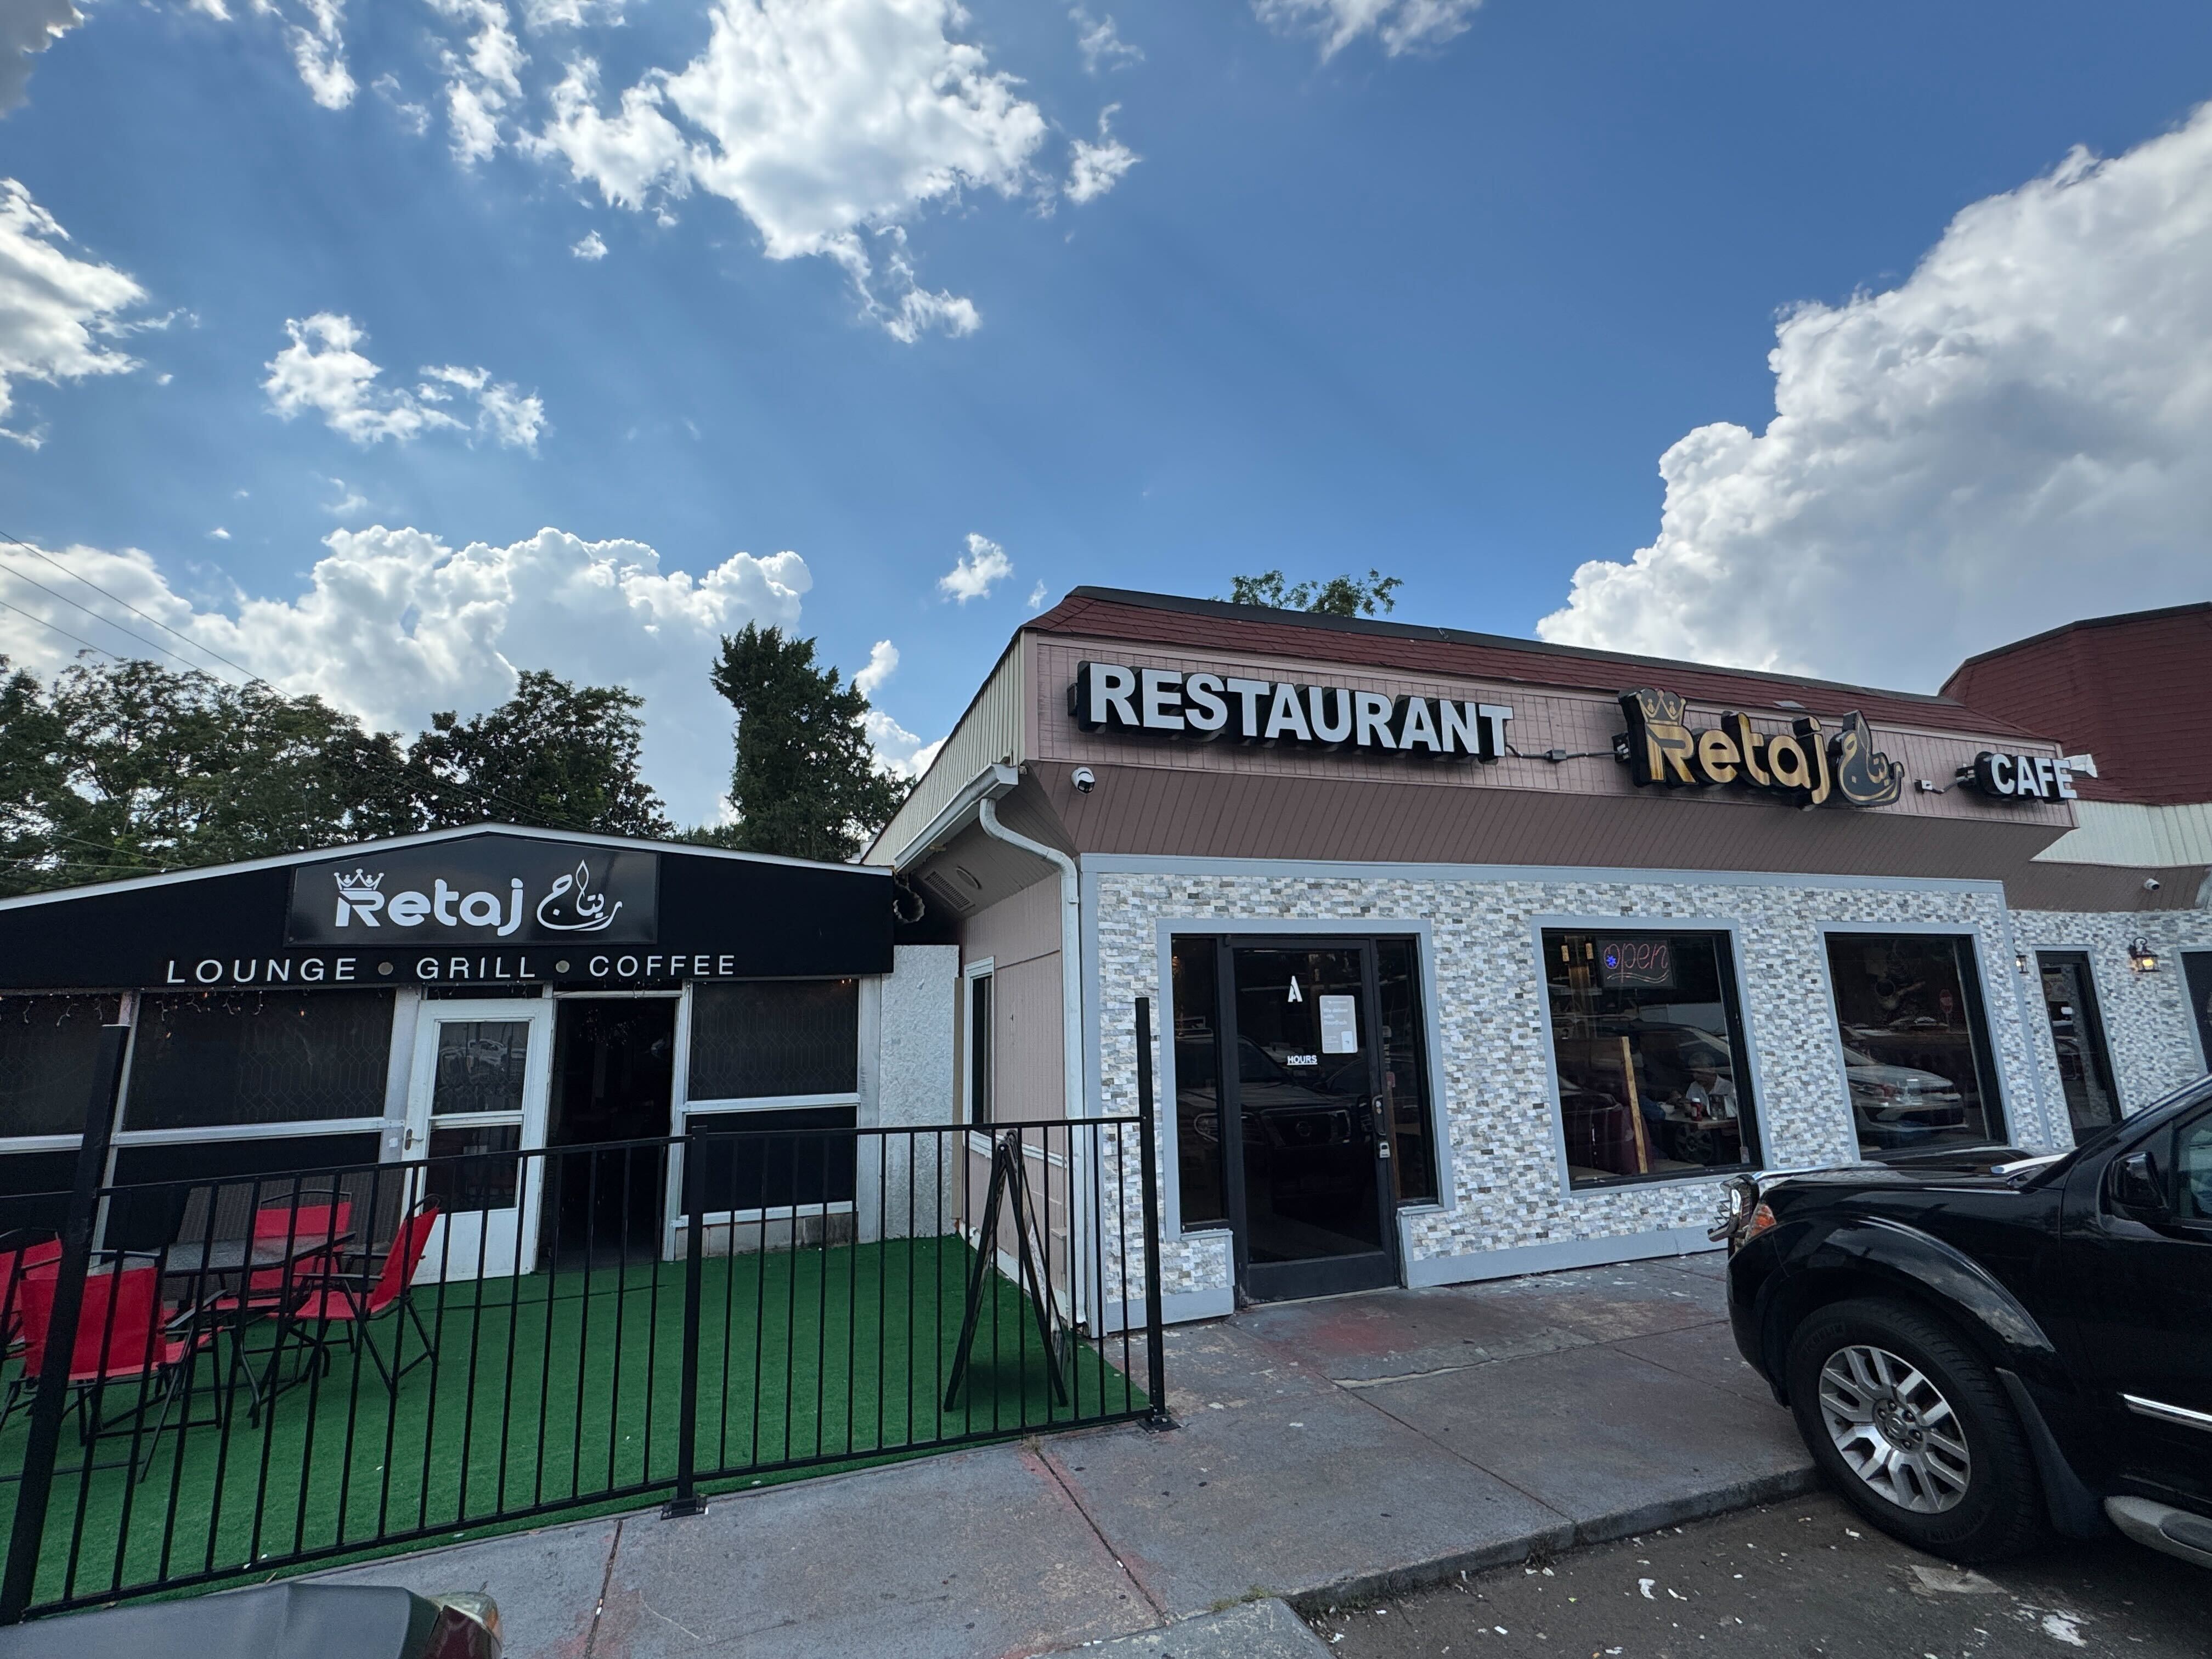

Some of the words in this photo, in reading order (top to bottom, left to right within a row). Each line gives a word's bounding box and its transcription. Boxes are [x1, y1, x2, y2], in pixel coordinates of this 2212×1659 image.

[1088, 662, 1514, 758] RESTAURANT
[1646, 712, 1830, 804] Retaj
[1991, 753, 2078, 799] CAFE
[335, 878, 524, 936] Retaj
[166, 957, 357, 983] LOUNGE
[416, 956, 536, 979] GRILL
[589, 955, 735, 978] COFFEE
[1287, 975, 1304, 1003] A
[1287, 1055, 1318, 1064] HOURS
